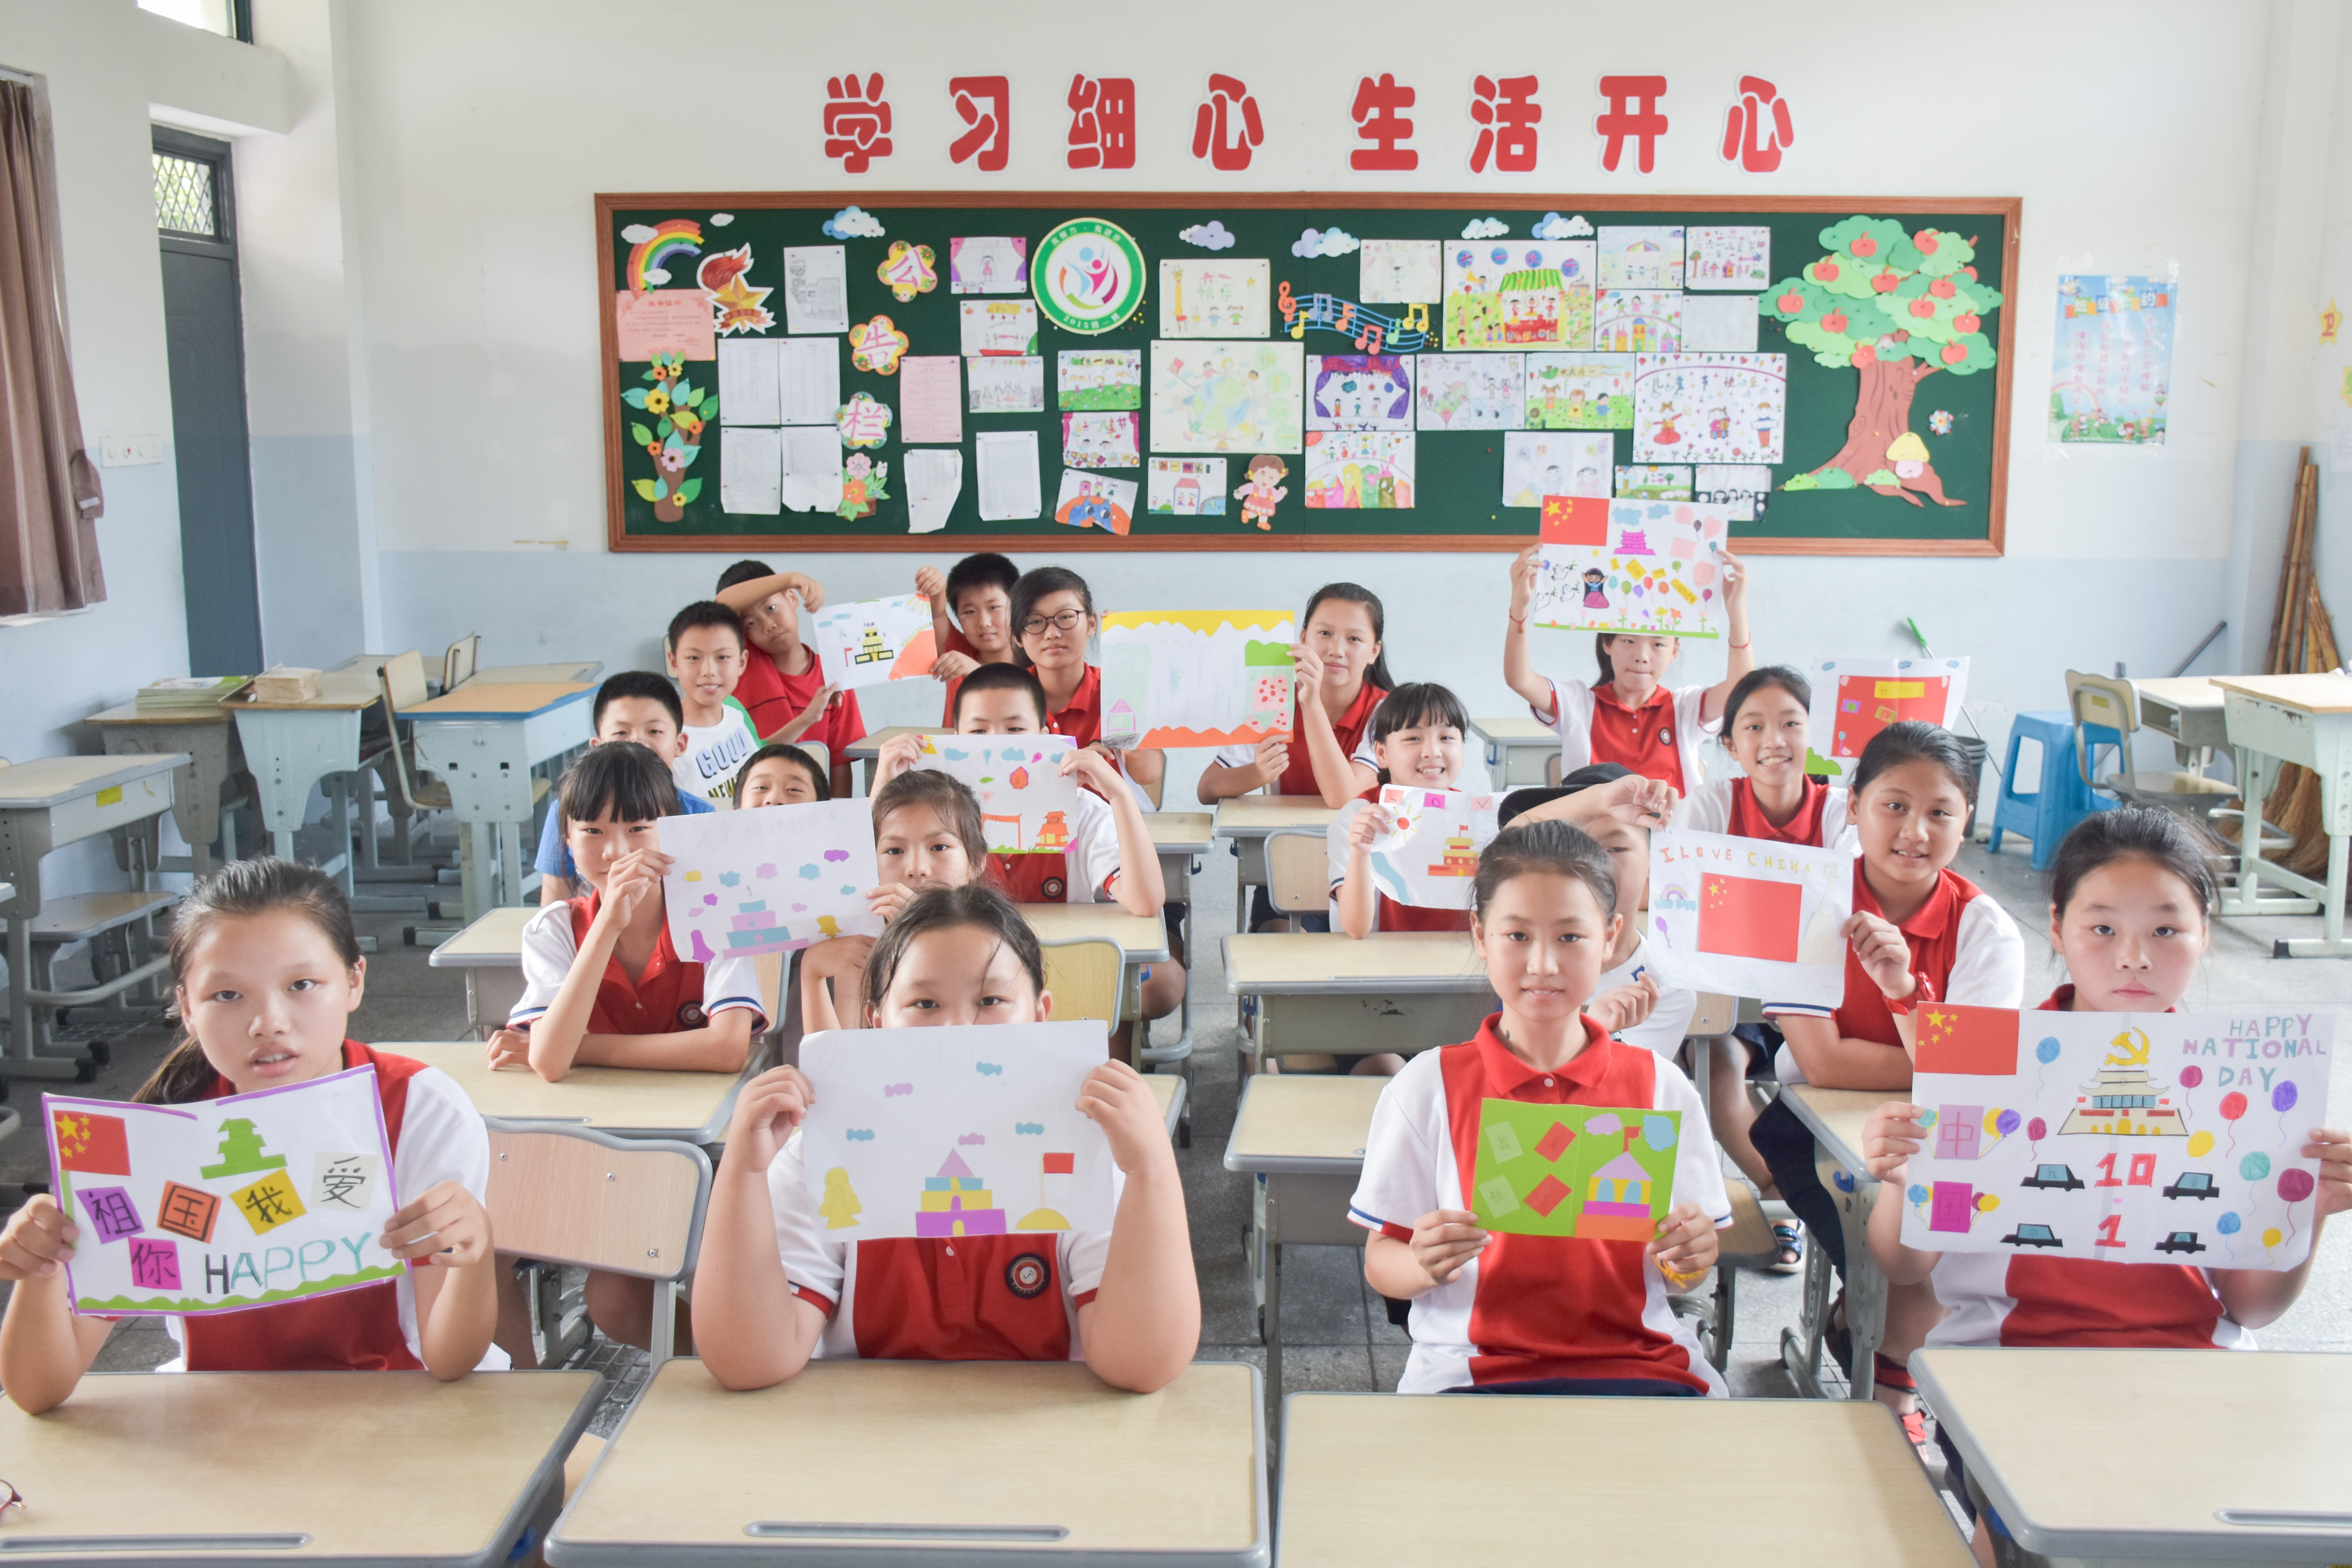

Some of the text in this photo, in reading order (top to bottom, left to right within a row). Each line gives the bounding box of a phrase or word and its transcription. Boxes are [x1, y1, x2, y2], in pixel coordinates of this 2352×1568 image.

[824, 73, 1793, 173] 学习细心 生活开心
[2230, 1014, 2313, 1036] HAPPY
[2183, 1037, 2327, 1059] NATIONAL
[2218, 1066, 2276, 1092] DAY
[132, 1242, 175, 1285] 你
[205, 1232, 372, 1294] HAPPY
